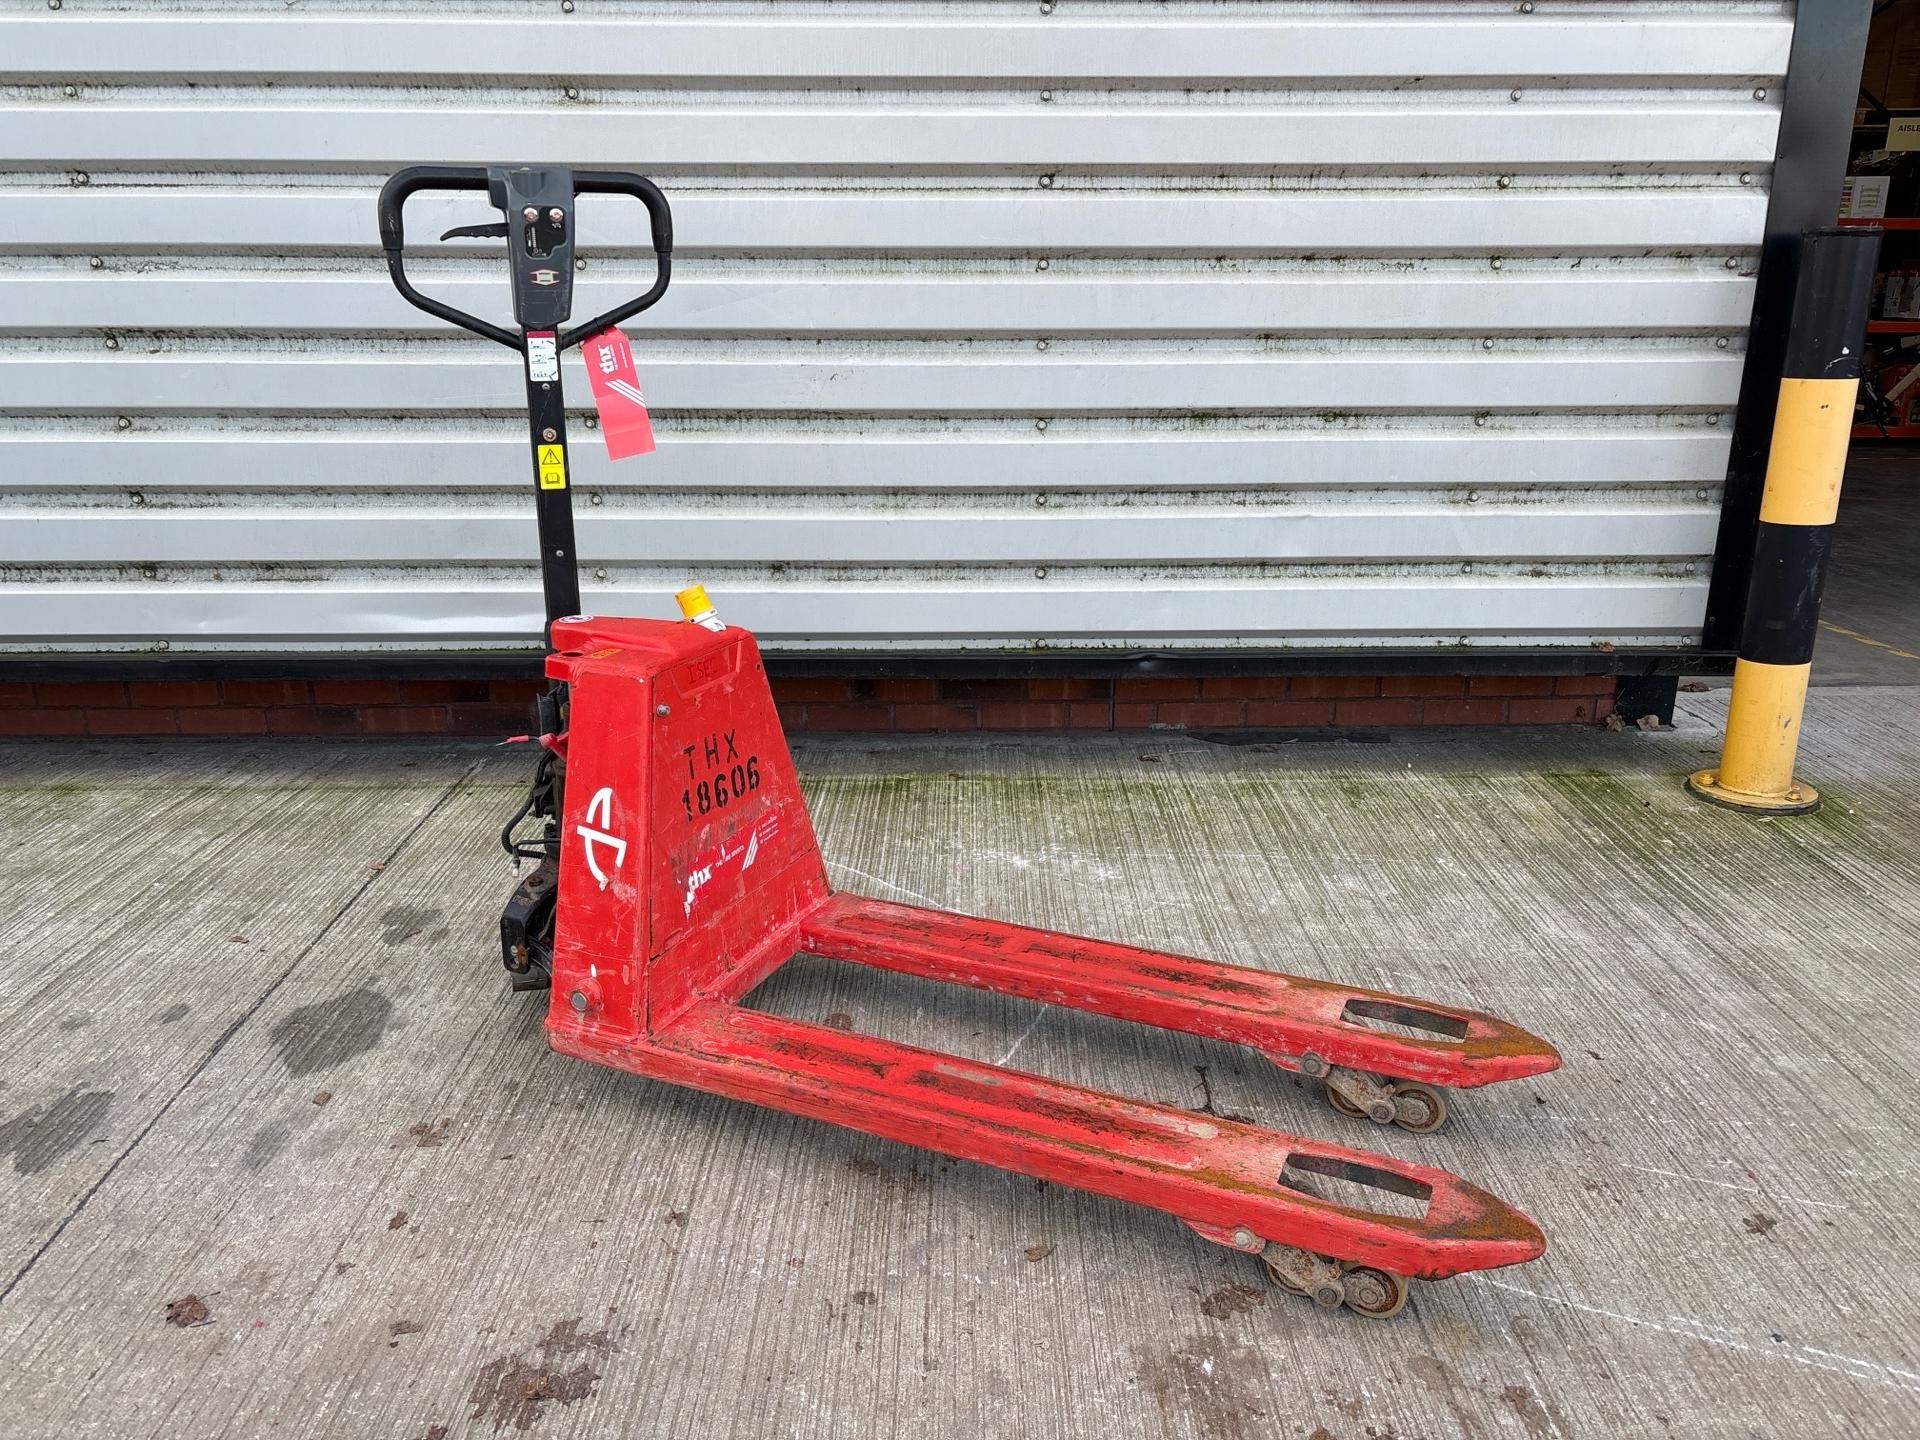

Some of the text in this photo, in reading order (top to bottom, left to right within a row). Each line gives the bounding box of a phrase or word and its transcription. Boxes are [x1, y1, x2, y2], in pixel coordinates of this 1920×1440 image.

[1896, 124, 1920, 132] AISLE
[683, 728, 739, 780] THX
[682, 755, 760, 822] 18606
